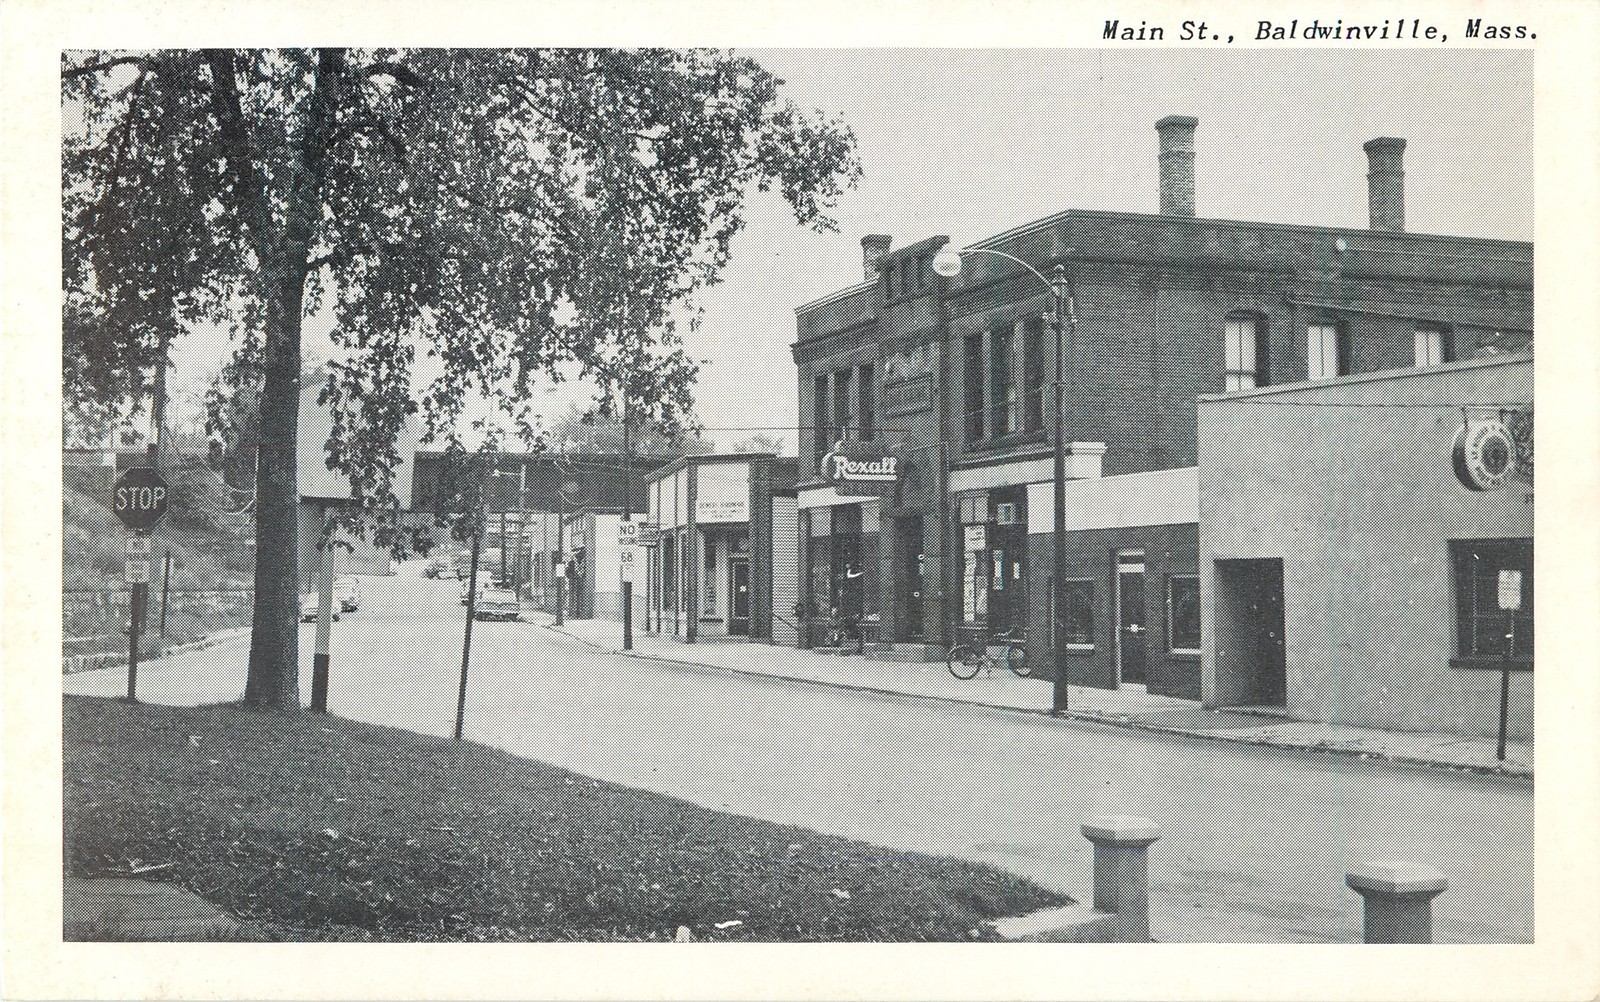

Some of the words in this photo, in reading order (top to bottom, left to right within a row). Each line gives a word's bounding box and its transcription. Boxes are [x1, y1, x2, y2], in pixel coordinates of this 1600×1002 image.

[833, 455, 898, 480] Rexall
[116, 487, 166, 510] STOP
[619, 525, 635, 535] NO
[621, 551, 633, 563] 68
